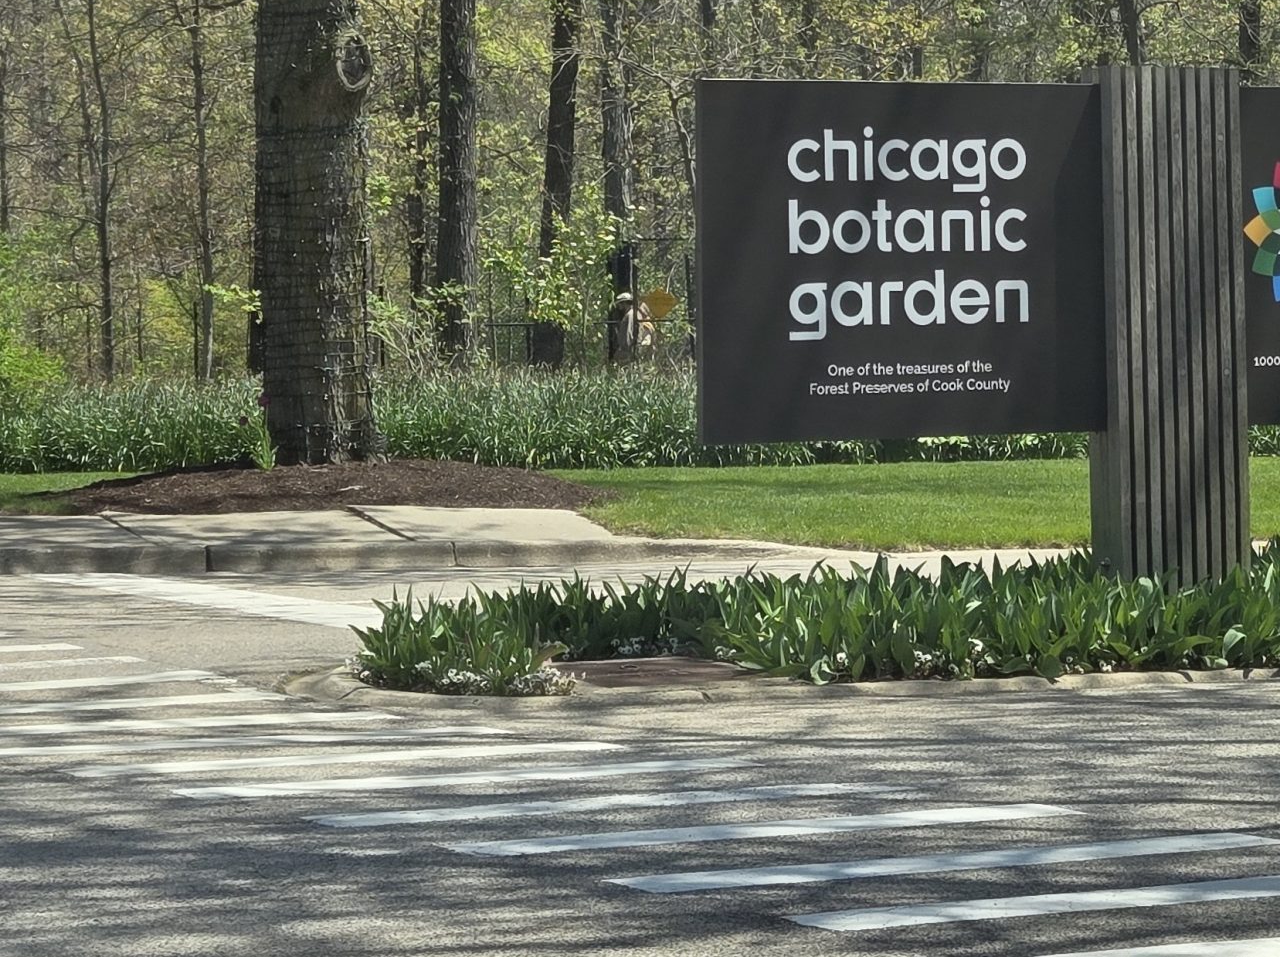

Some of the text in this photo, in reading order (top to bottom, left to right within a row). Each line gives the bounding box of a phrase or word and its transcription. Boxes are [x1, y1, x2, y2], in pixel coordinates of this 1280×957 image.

[787, 125, 1027, 193] chicago
[788, 195, 1028, 255] botanic
[789, 268, 1030, 341] garden
[827, 359, 993, 377] One of the treasures of the
[1253, 355, 1280, 367] 1000
[809, 377, 1011, 396] Forest Preserves of Cook County
